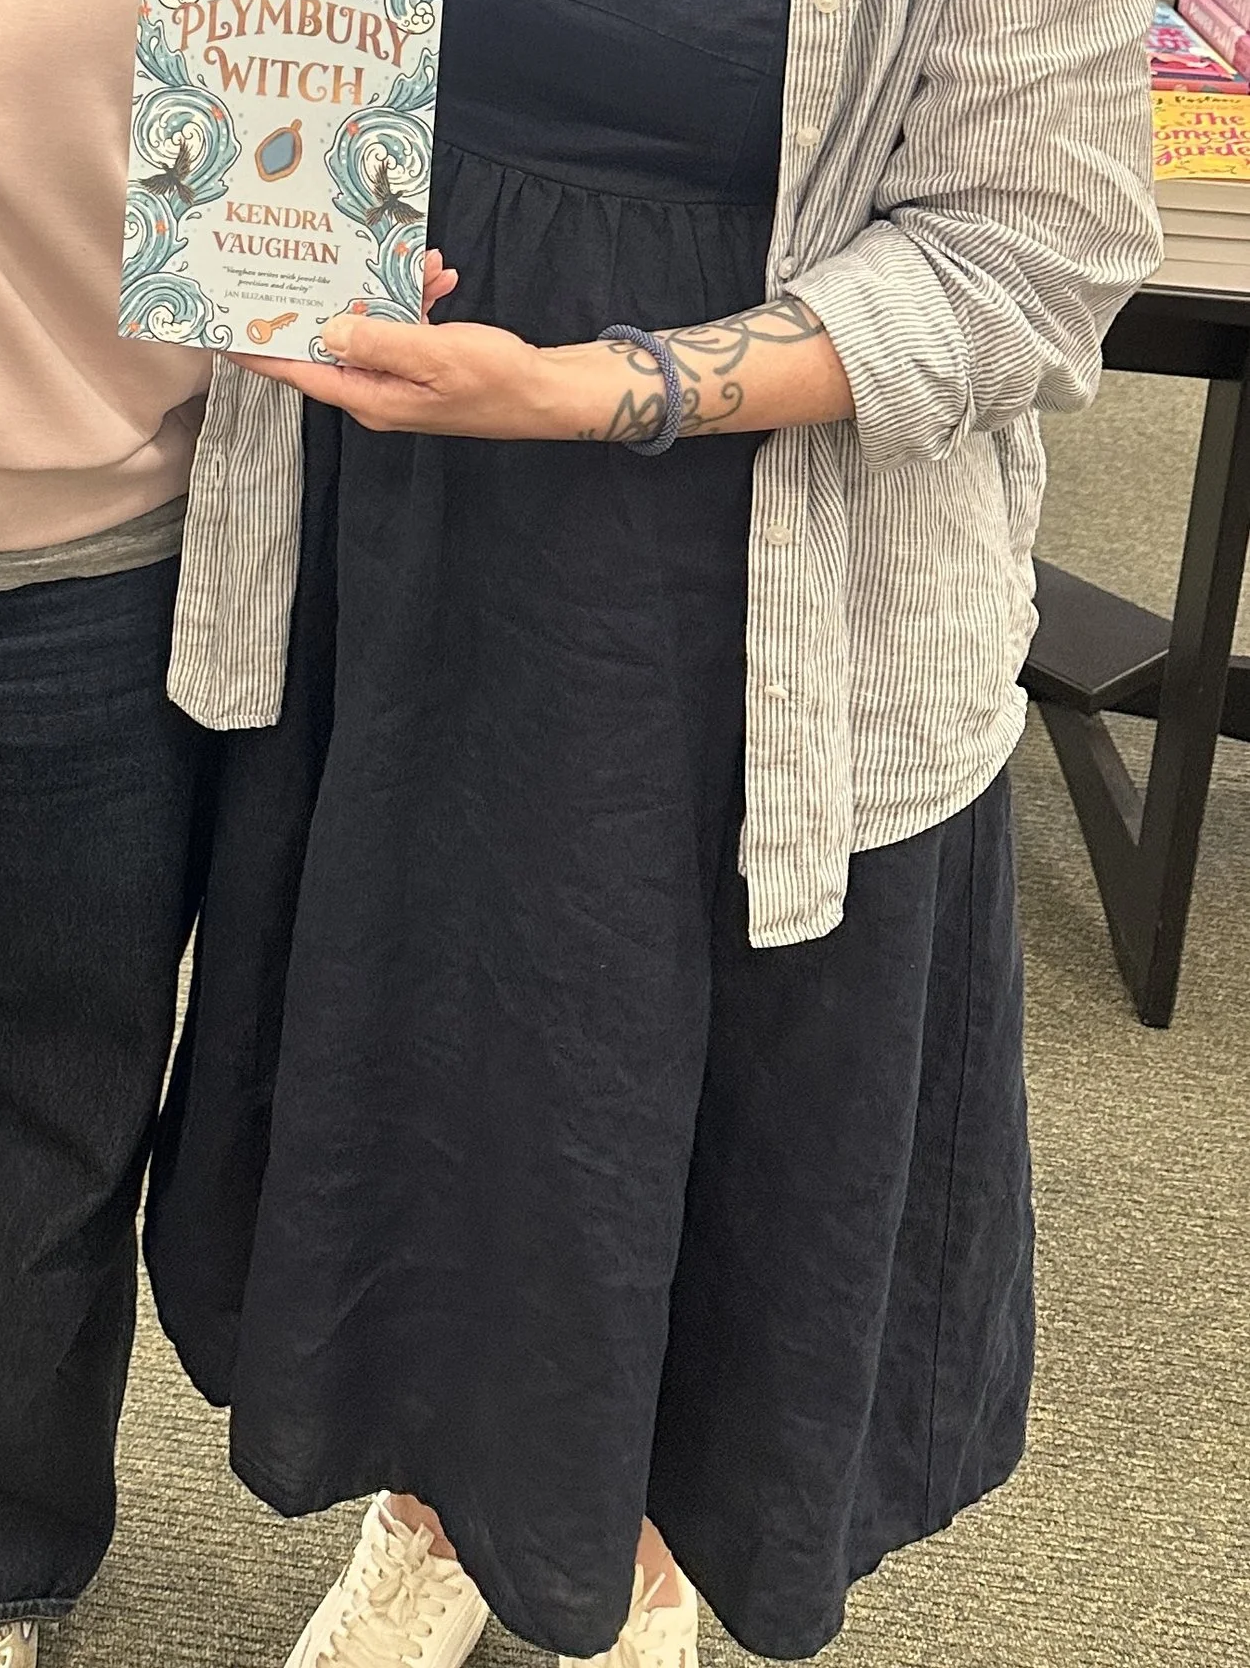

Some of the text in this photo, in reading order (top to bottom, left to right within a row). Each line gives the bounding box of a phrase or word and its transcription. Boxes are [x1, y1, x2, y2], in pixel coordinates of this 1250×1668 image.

[203, 46, 365, 105] WITCH
[225, 201, 333, 233] KENDRA
[212, 230, 341, 265] VAUGHAN
[224, 290, 324, 307] JAN ELIZABETH WATSON
[270, 281, 285, 290] and
